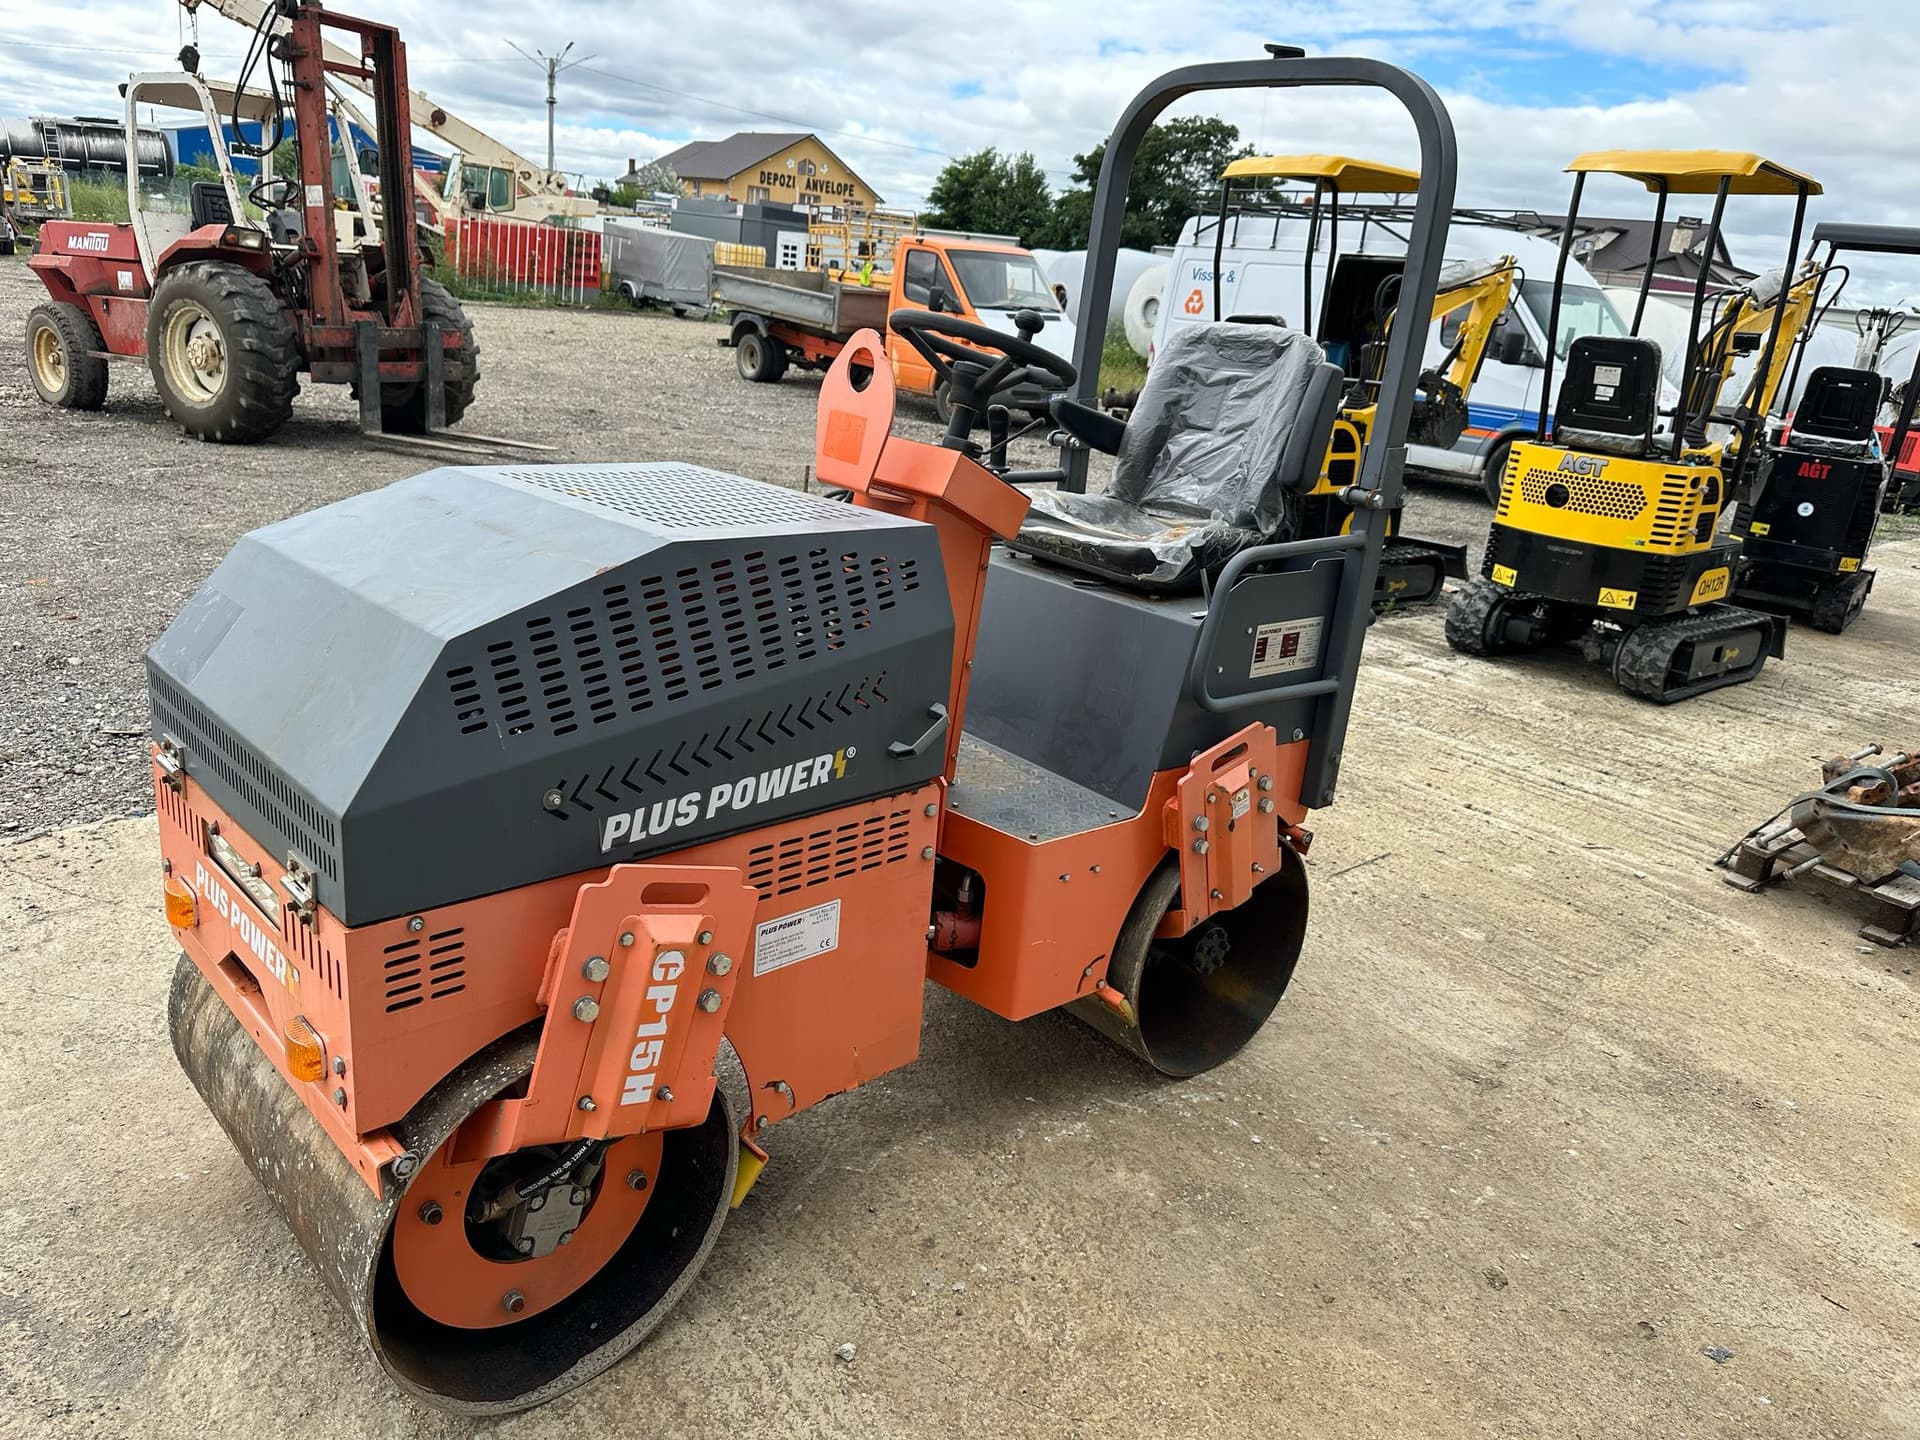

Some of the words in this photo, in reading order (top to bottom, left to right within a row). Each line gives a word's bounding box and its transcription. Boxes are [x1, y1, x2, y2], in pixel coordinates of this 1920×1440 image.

[760, 171, 796, 189] DEPOZI
[805, 178, 855, 197] ANVELOPE
[68, 232, 109, 251] MANITOU
[1192, 268, 1225, 281] Vissr
[1227, 270, 1235, 283] &
[1558, 453, 1609, 477] AGT
[1797, 461, 1832, 479] AGT
[601, 791, 701, 854] PLUS
[705, 753, 833, 819] POWER
[196, 860, 229, 919] PLUS
[230, 900, 286, 986] POWER
[761, 925, 777, 937] PLUS
[778, 918, 802, 931] POWER
